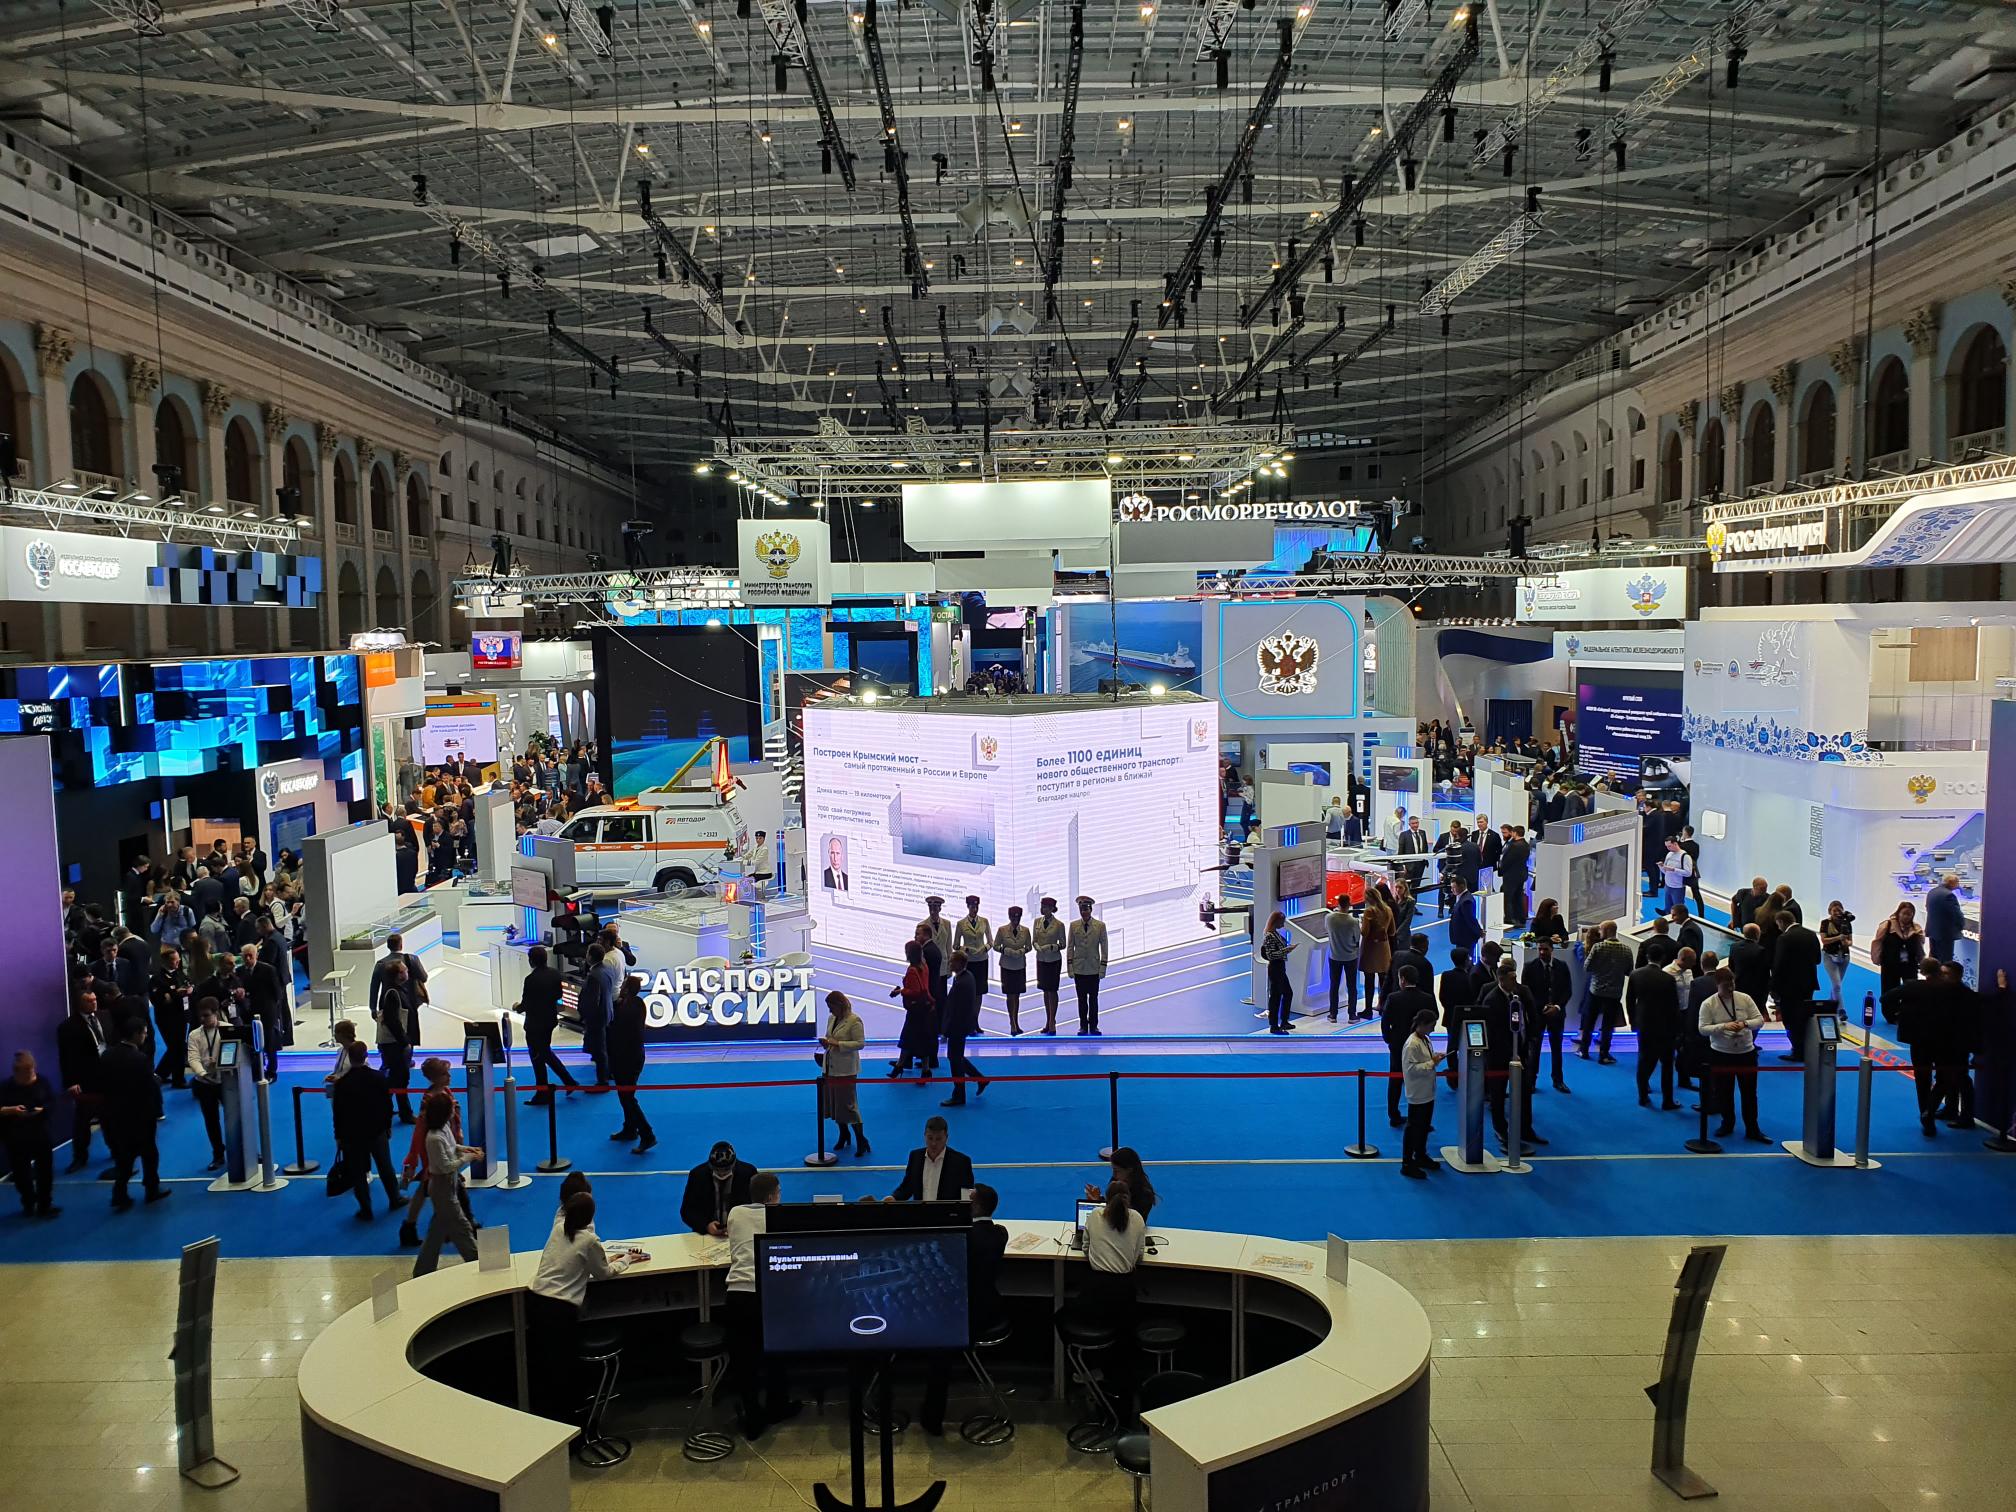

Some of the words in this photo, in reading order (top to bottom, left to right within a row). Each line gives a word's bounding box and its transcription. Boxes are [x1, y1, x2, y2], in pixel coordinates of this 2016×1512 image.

[1157, 500, 1360, 521] РОСМОРРЕЧФЛОТ
[1726, 522, 1826, 553] РОСАВИАЦИЯ
[813, 747, 851, 759] Построен
[853, 749, 896, 762] Крымский
[898, 755, 919, 764] мост
[1036, 757, 1066, 768] Более
[1067, 749, 1093, 764] 1100
[1096, 746, 1143, 762] единиц
[844, 761, 866, 770] самый
[867, 764, 916, 775] протяженный
[923, 767, 951, 777] России
[959, 769, 988, 781] Европе
[1036, 769, 1068, 780] нового
[1070, 762, 1137, 777] общественного
[816, 787, 832, 795] Длина
[1036, 780, 1075, 793] поступит
[1082, 776, 1116, 789] регионы
[1037, 793, 1068, 803] благодаря
[631, 968, 815, 993] РАНСПОРТ
[644, 990, 817, 1028] ОССИИ
[769, 1252, 859, 1263] Мультипликативный
[769, 1262, 802, 1272] эффект
[1275, 1469, 1357, 1512] ТРАНСПОРТ
